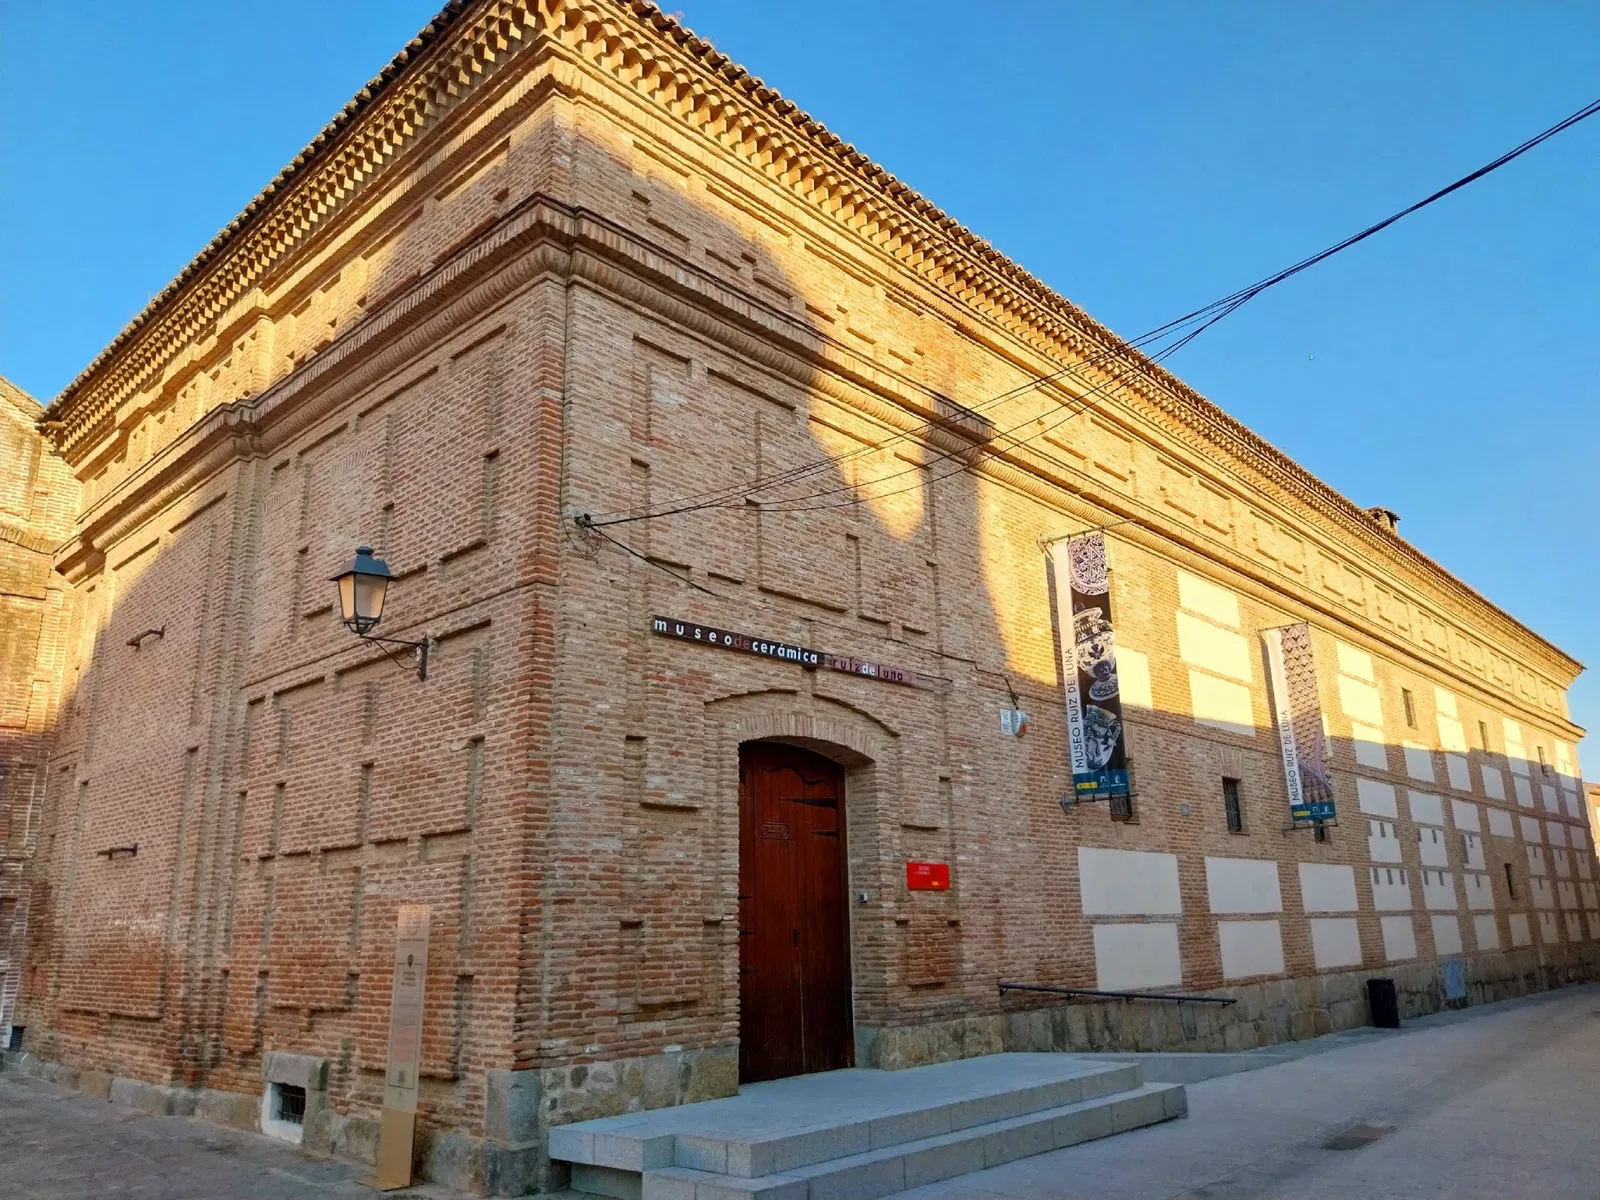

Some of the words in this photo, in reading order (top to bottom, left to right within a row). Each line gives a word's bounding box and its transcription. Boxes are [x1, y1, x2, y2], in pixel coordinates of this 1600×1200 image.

[654, 619, 732, 646] museo
[752, 641, 818, 664] cerámica
[1065, 648, 1074, 676] LUNA
[1067, 680, 1076, 693] DE
[1069, 698, 1079, 723] RUIZ
[1281, 710, 1289, 732] LUNA
[1072, 727, 1085, 769] MUSEO
[1284, 734, 1291, 745] DE
[1285, 748, 1294, 767] RUIZ
[1288, 770, 1299, 801] MUSEO
